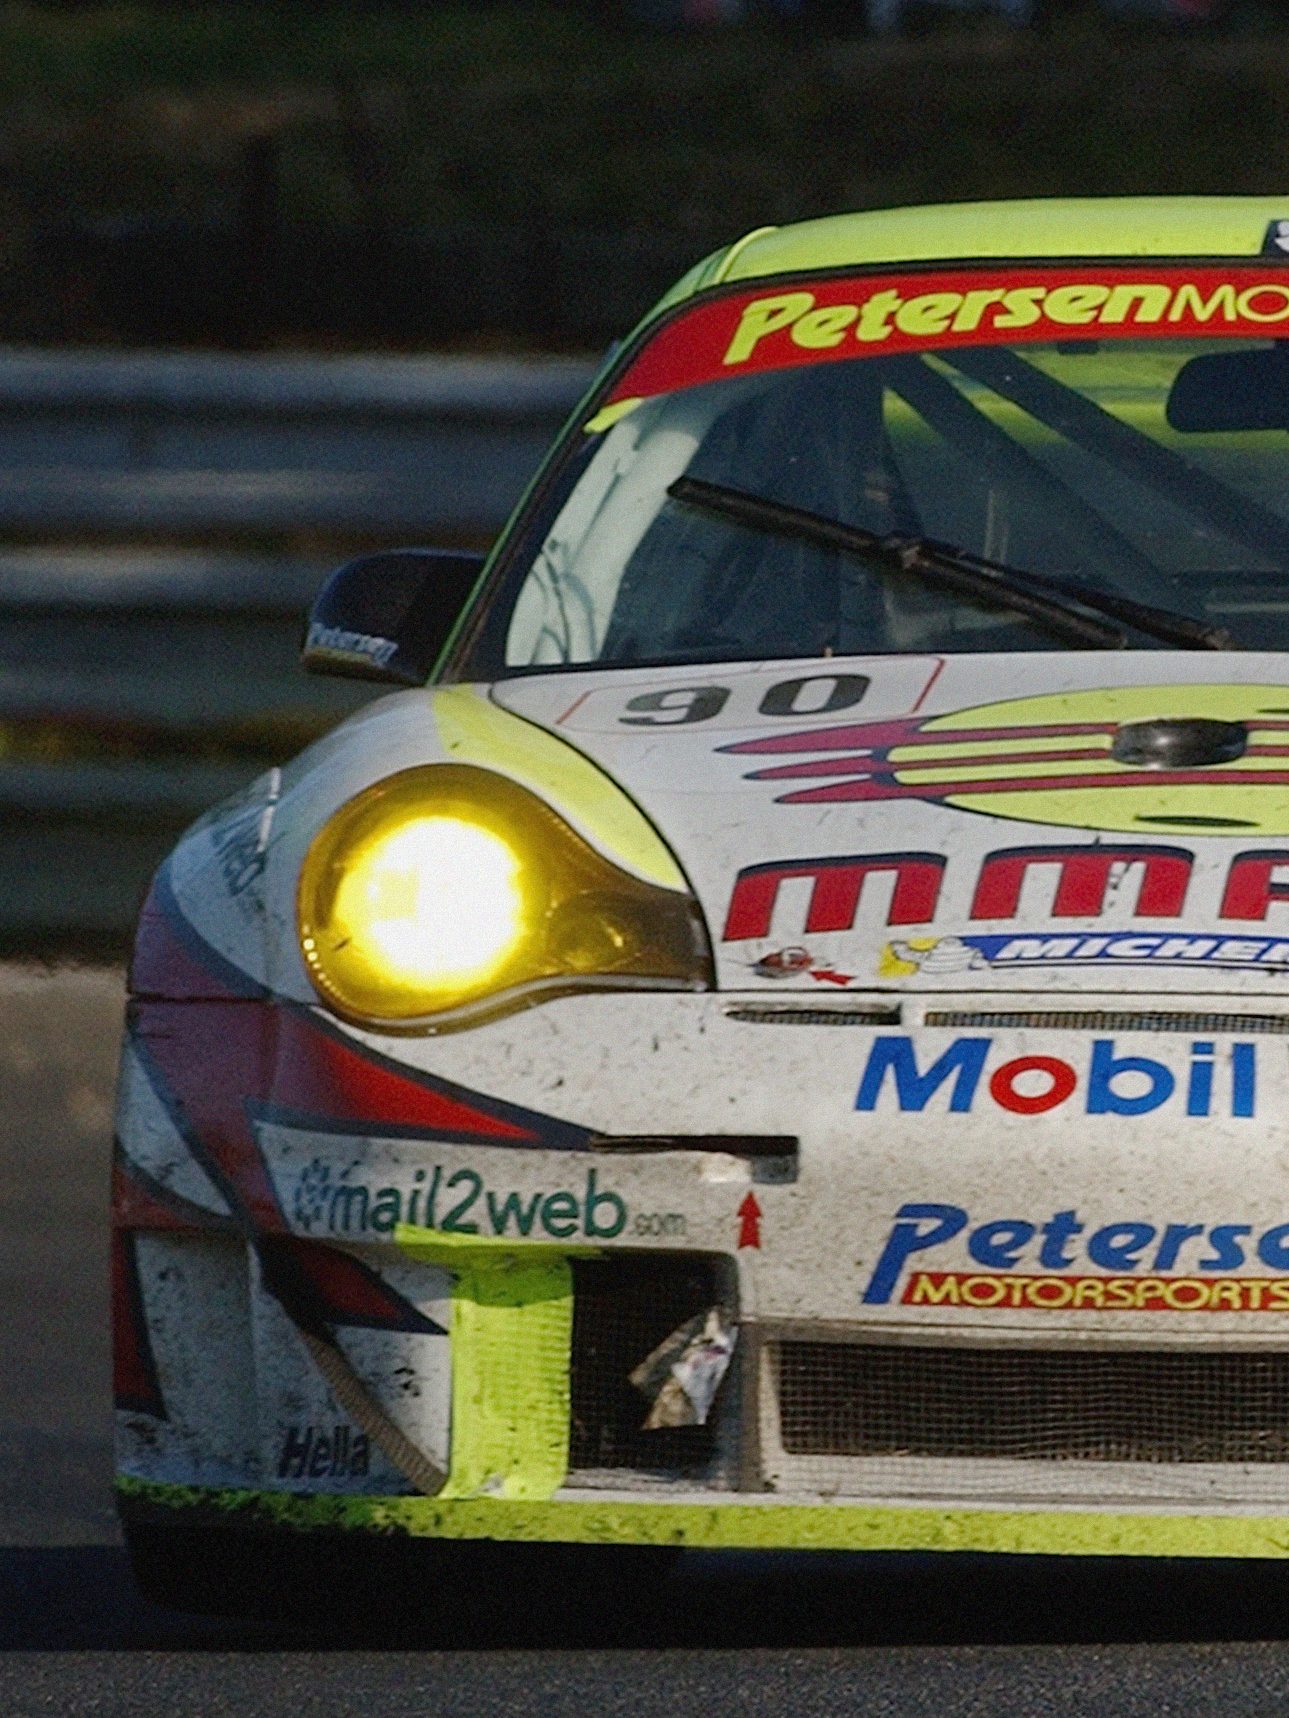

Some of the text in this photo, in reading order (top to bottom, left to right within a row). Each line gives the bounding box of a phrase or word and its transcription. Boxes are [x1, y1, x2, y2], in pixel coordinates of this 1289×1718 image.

[618, 674, 871, 726] 90
[854, 1036, 1257, 1118] Mobil
[277, 1426, 370, 1479] Hella
